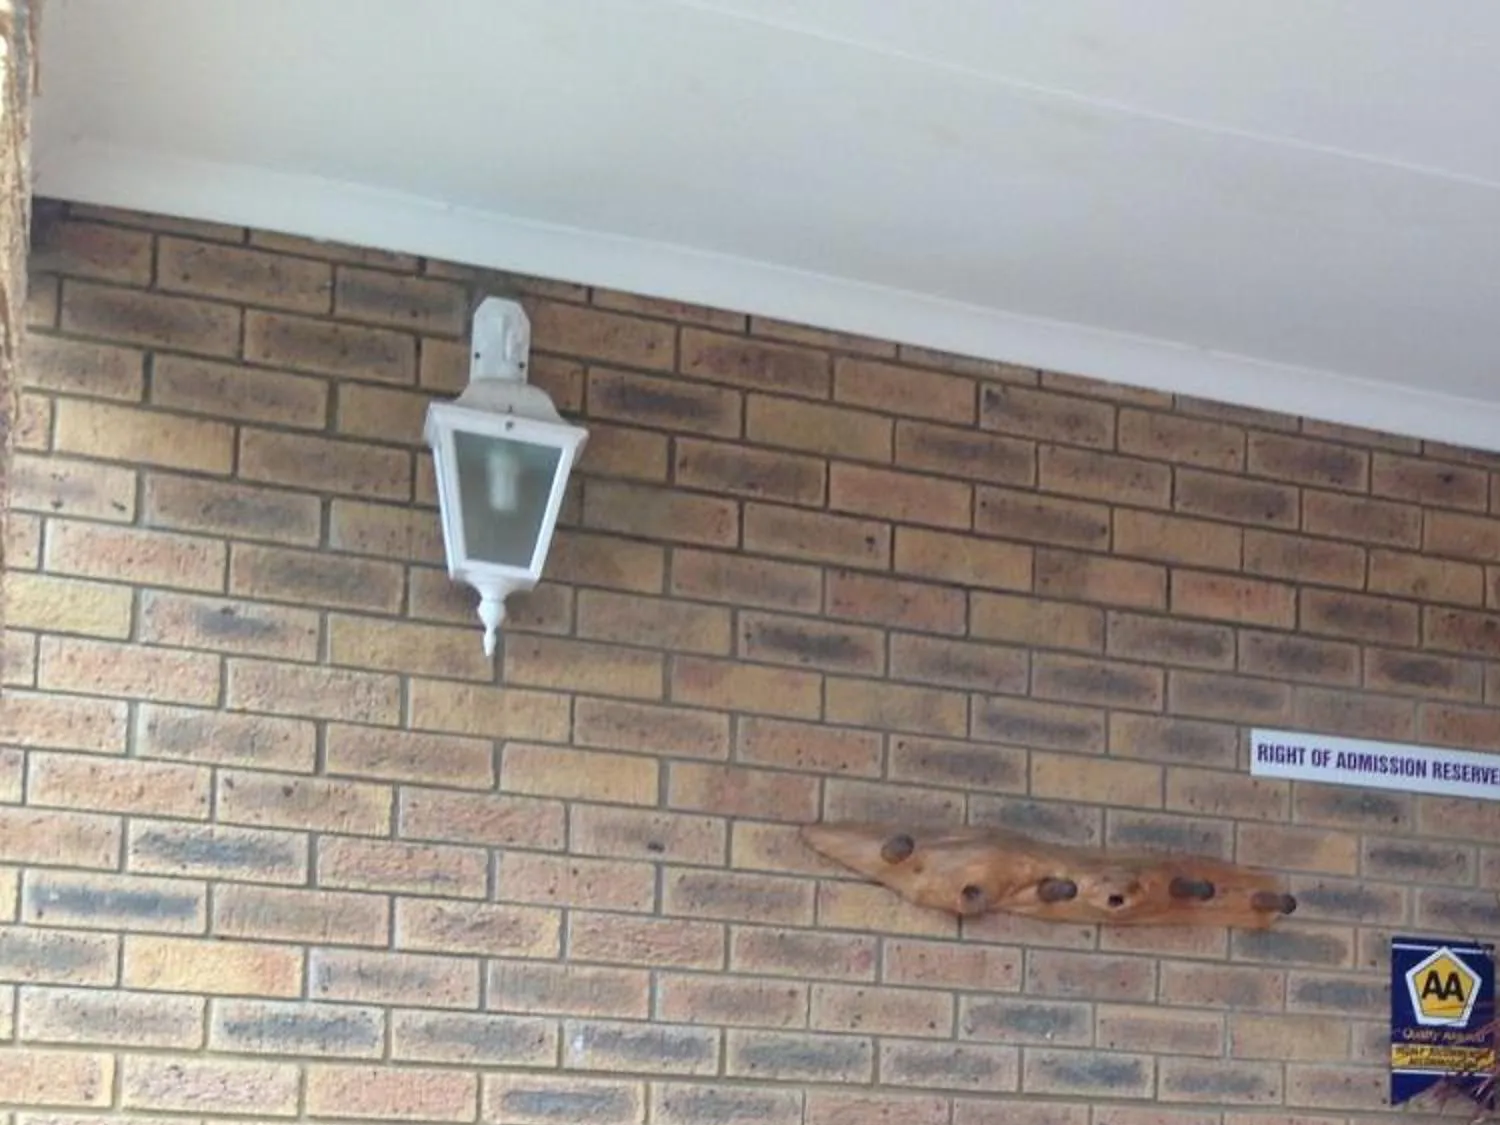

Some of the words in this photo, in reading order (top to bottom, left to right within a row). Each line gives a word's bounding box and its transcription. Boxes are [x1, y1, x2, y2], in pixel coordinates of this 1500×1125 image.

[1257, 743, 1305, 765] RIGHT
[1311, 750, 1331, 769] OF
[1336, 751, 1427, 778] ADMISSION
[1421, 970, 1465, 1002] AA
